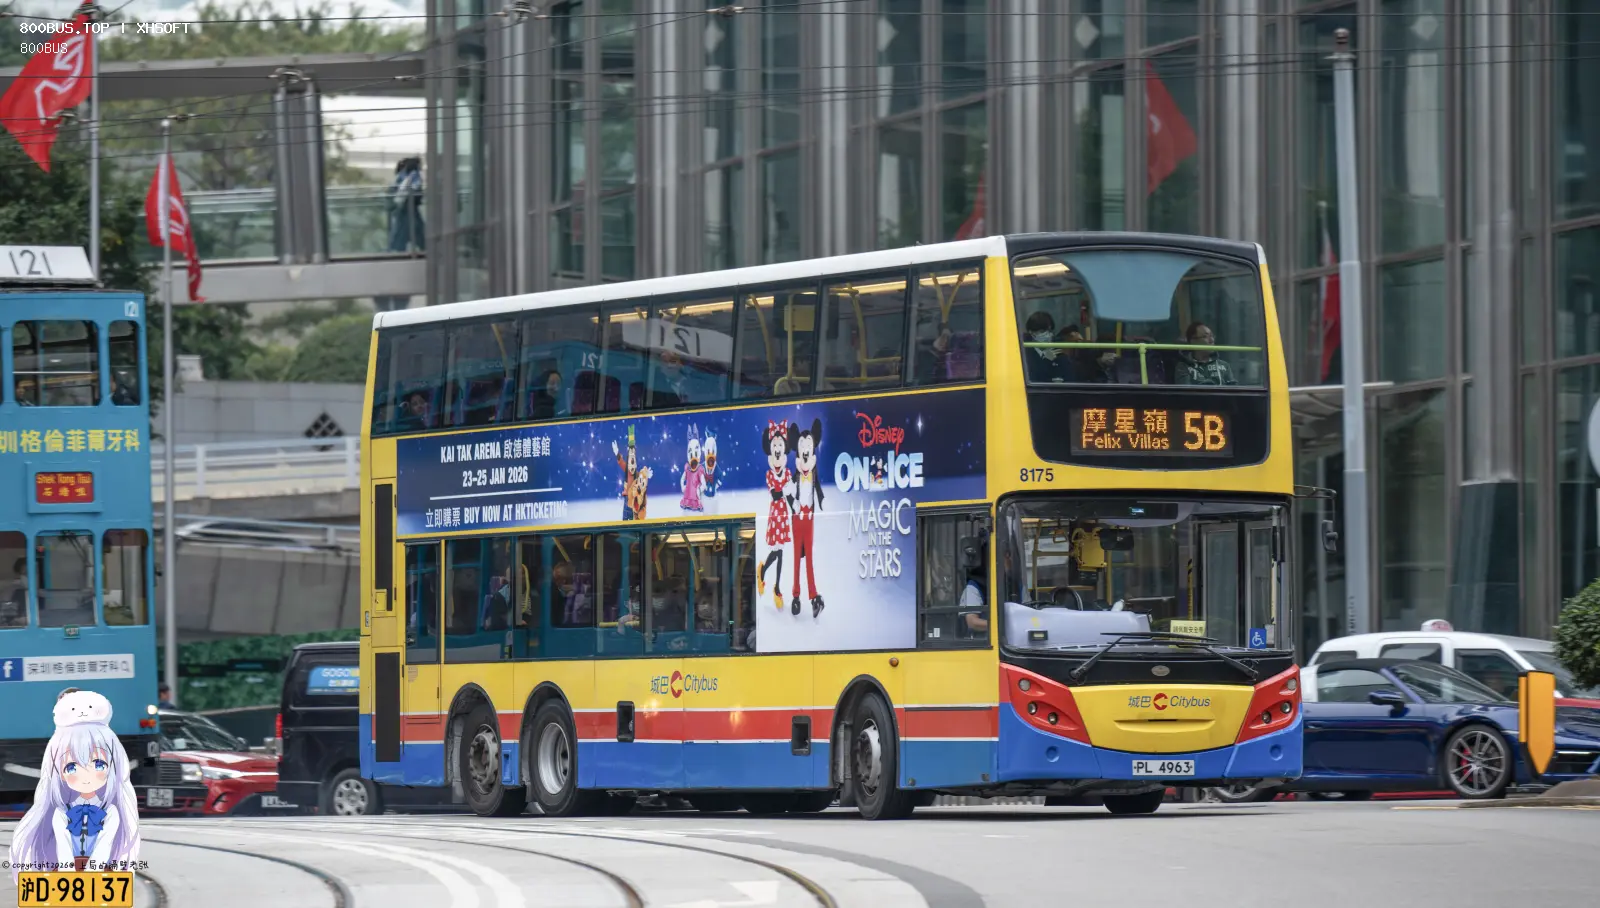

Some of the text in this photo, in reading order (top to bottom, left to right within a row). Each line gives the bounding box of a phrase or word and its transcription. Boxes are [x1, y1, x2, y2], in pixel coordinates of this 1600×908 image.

[8, 249, 53, 276] 121
[1082, 408, 1168, 434] 摩星嶺
[1183, 411, 1227, 451] 5B
[440, 445, 455, 464] KAI
[456, 443, 473, 462] TAK
[474, 440, 501, 460] ARENA
[1082, 432, 1170, 450] Felix Villas
[489, 468, 506, 485] JAN
[507, 465, 529, 484] 2026
[834, 450, 924, 493] ON ICE
[1019, 468, 1054, 482] 8175
[425, 500, 568, 528] 立即購票 BUY NOW AT HKTICKETING
[848, 498, 911, 540] MAGIC
[868, 531, 892, 546] IN THE
[859, 547, 901, 578] STARS
[650, 674, 718, 694] 城巴 Citybus
[1128, 695, 1211, 708] 城巴 Citybus
[1136, 761, 1190, 774] PL 4963
